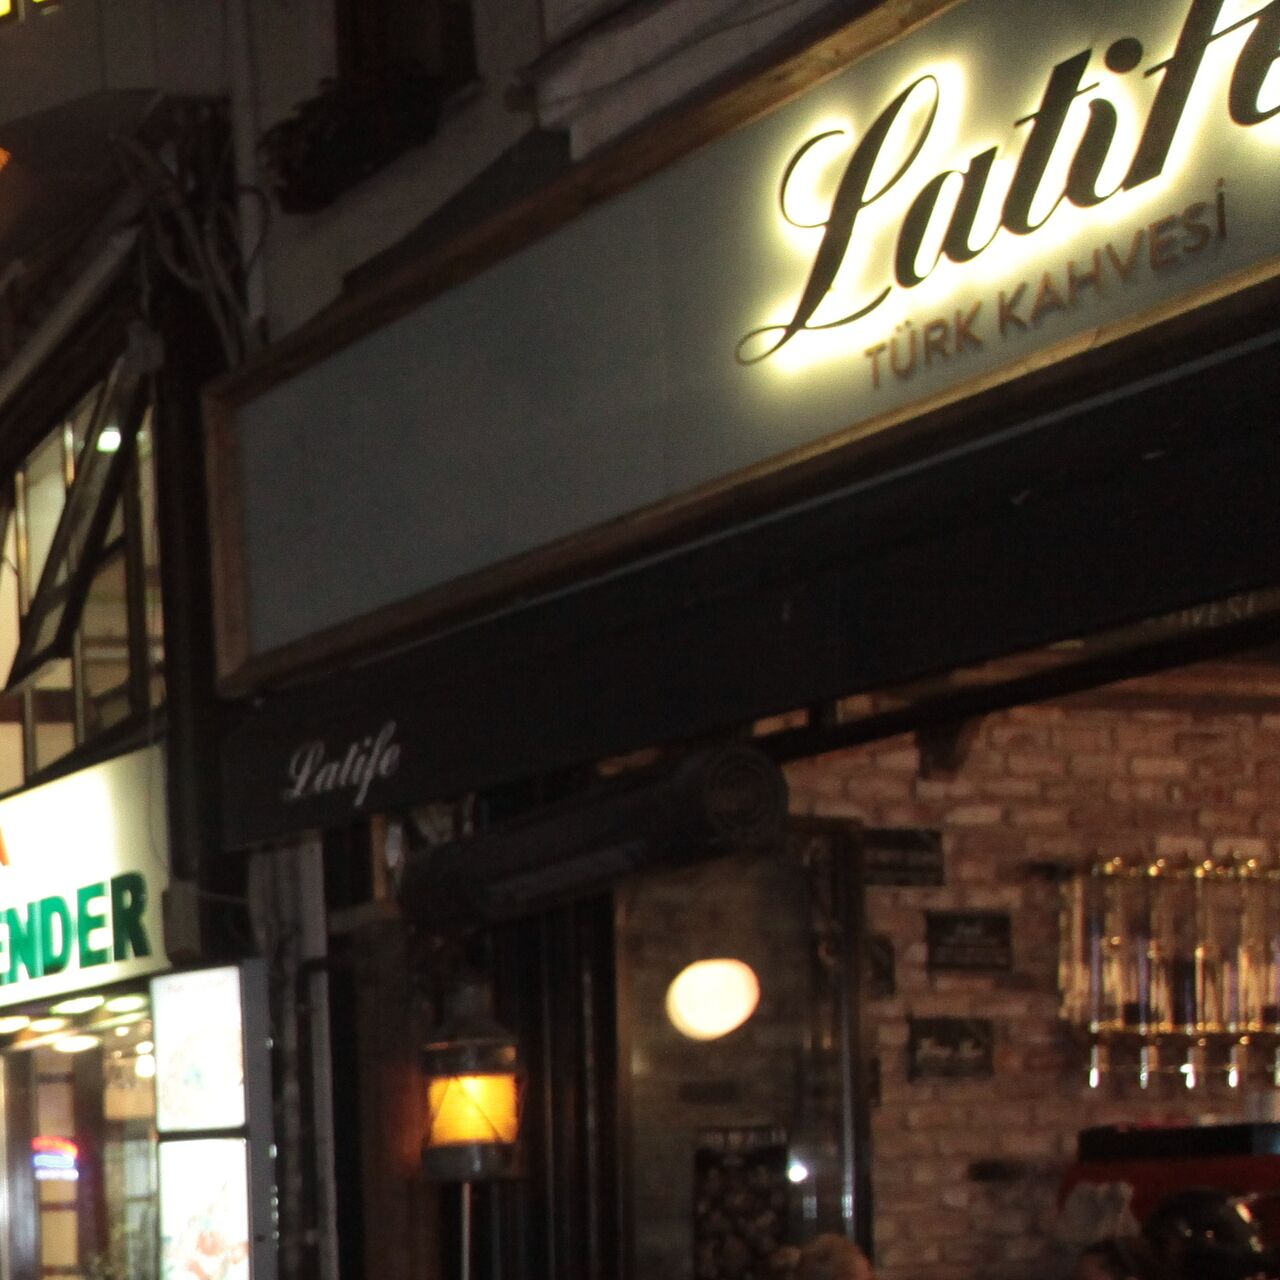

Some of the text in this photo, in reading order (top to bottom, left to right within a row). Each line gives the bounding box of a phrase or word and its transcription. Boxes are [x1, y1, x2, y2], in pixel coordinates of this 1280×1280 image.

[864, 177, 1228, 389] TÜRK KAHVESİ
[282, 720, 400, 807] Latife
